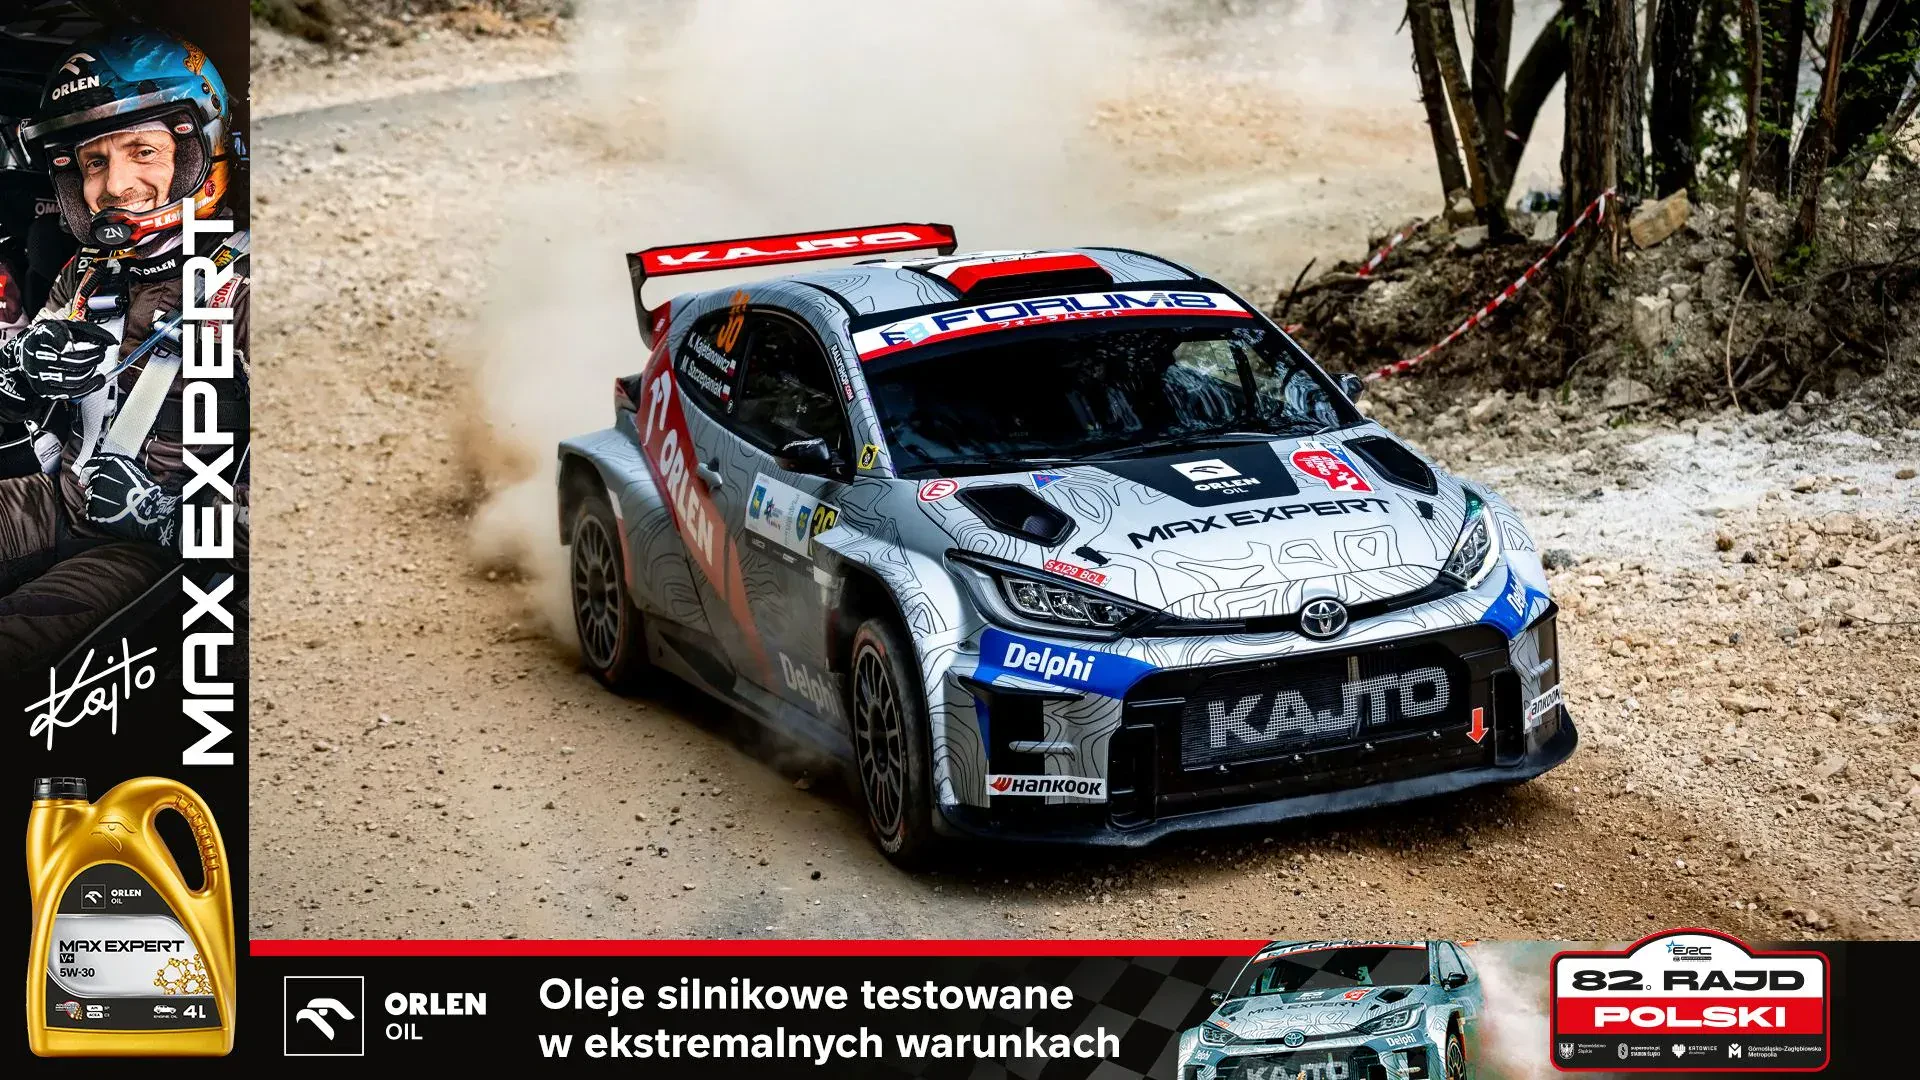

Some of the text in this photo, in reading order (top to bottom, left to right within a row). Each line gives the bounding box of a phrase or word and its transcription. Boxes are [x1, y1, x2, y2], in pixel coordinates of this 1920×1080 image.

[51, 75, 100, 101] ORLEN
[657, 231, 922, 266] KAJTO
[143, 259, 176, 276] ORLEN
[931, 292, 1217, 331] FORUM8
[1194, 476, 1260, 492] ORLEN
[1222, 487, 1250, 496] OIL
[660, 428, 714, 566] ORLEN
[1127, 498, 1391, 550] MAX EXPERT
[1080, 568, 1101, 584] BCL
[1003, 642, 1096, 682] Delphi
[778, 651, 841, 719] Delphi
[1208, 666, 1451, 749] KAJTO
[110, 889, 142, 897] ORLEN
[59, 940, 185, 952] MAX EXPERT
[61, 954, 74, 963] V+
[59, 968, 96, 978] 5W-30
[1385, 1032, 1417, 1047] Delphi
